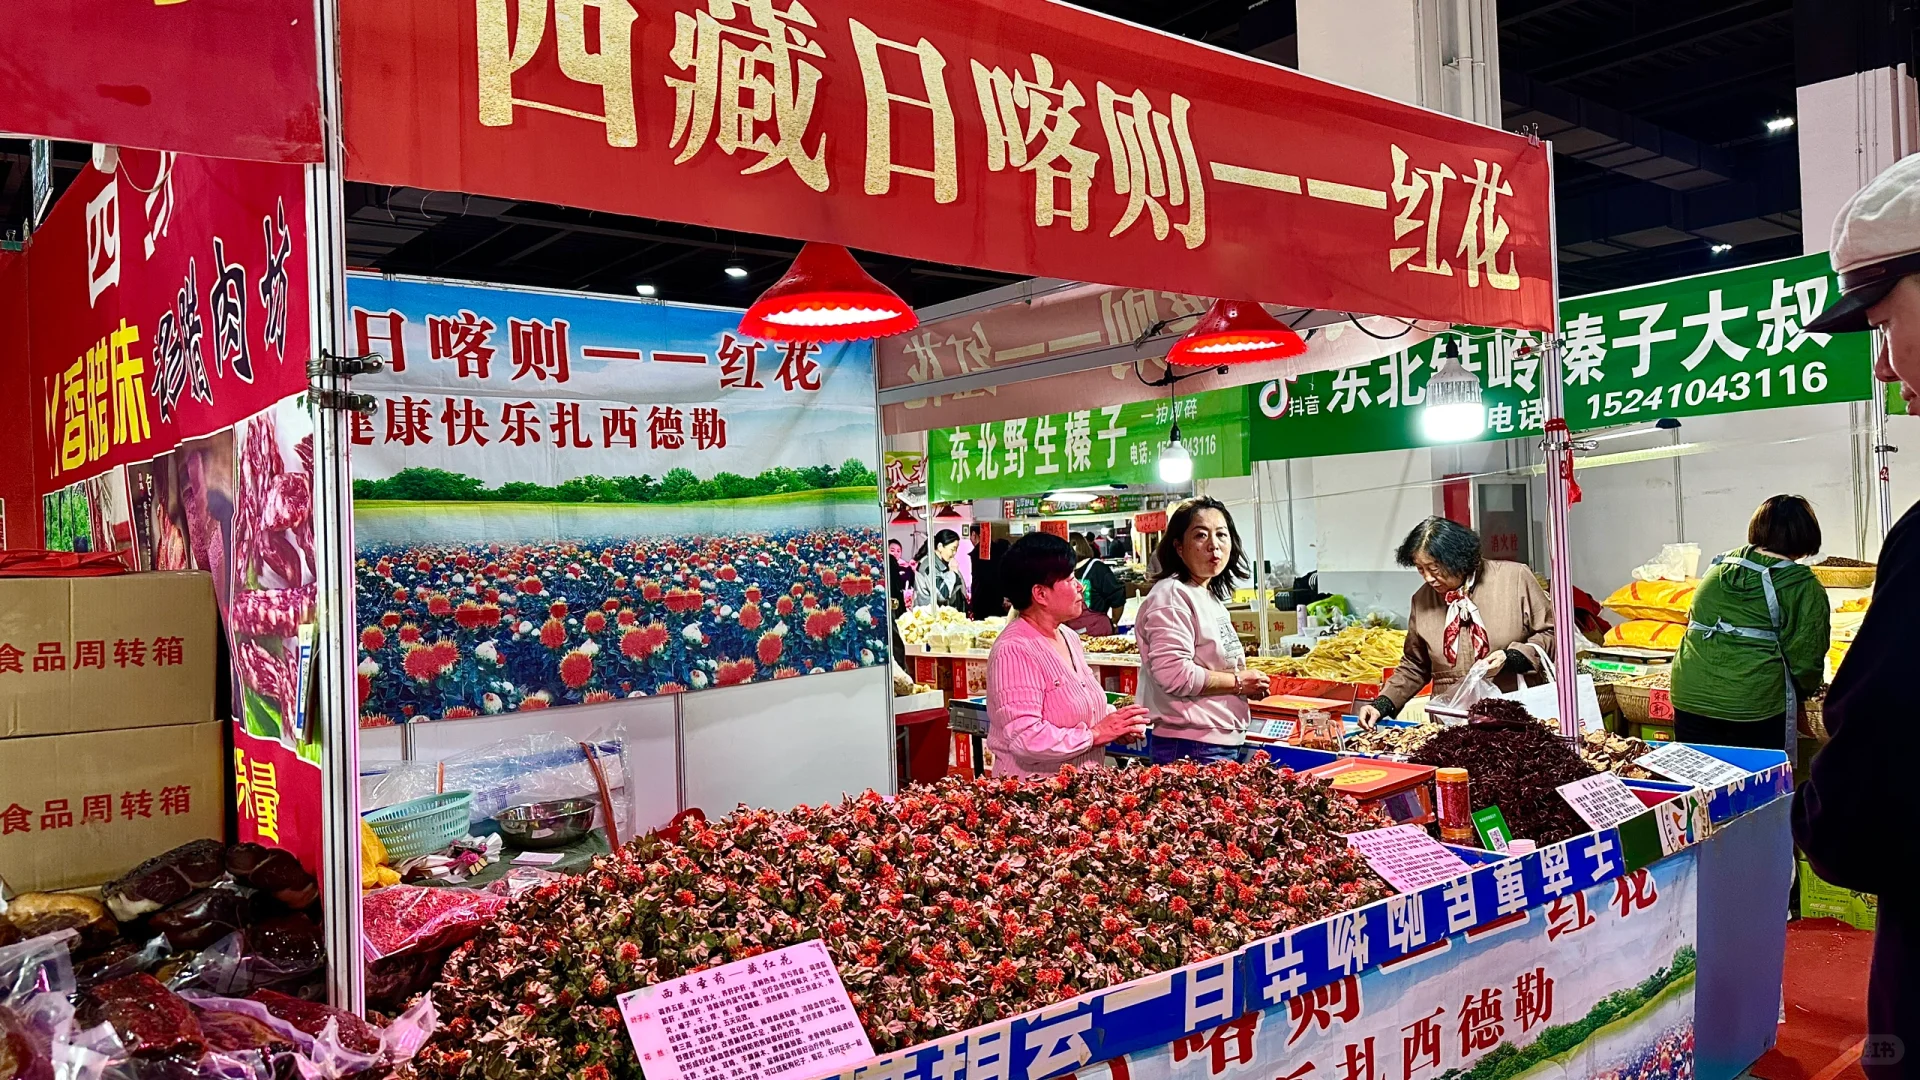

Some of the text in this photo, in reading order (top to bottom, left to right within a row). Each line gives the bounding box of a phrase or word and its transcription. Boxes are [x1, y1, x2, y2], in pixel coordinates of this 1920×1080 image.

[1140, 398, 1198, 426] 一拍即碎
[1289, 395, 1320, 417] 抖音
[1587, 360, 1828, 420] 15241043116
[948, 404, 1128, 484] 东北野生榛子
[1156, 434, 1216, 461] 15043116
[0, 636, 185, 675] 食品周转箱
[0, 785, 192, 836] 食品周转箱
[1274, 967, 1554, 1080] 扎西德勒
